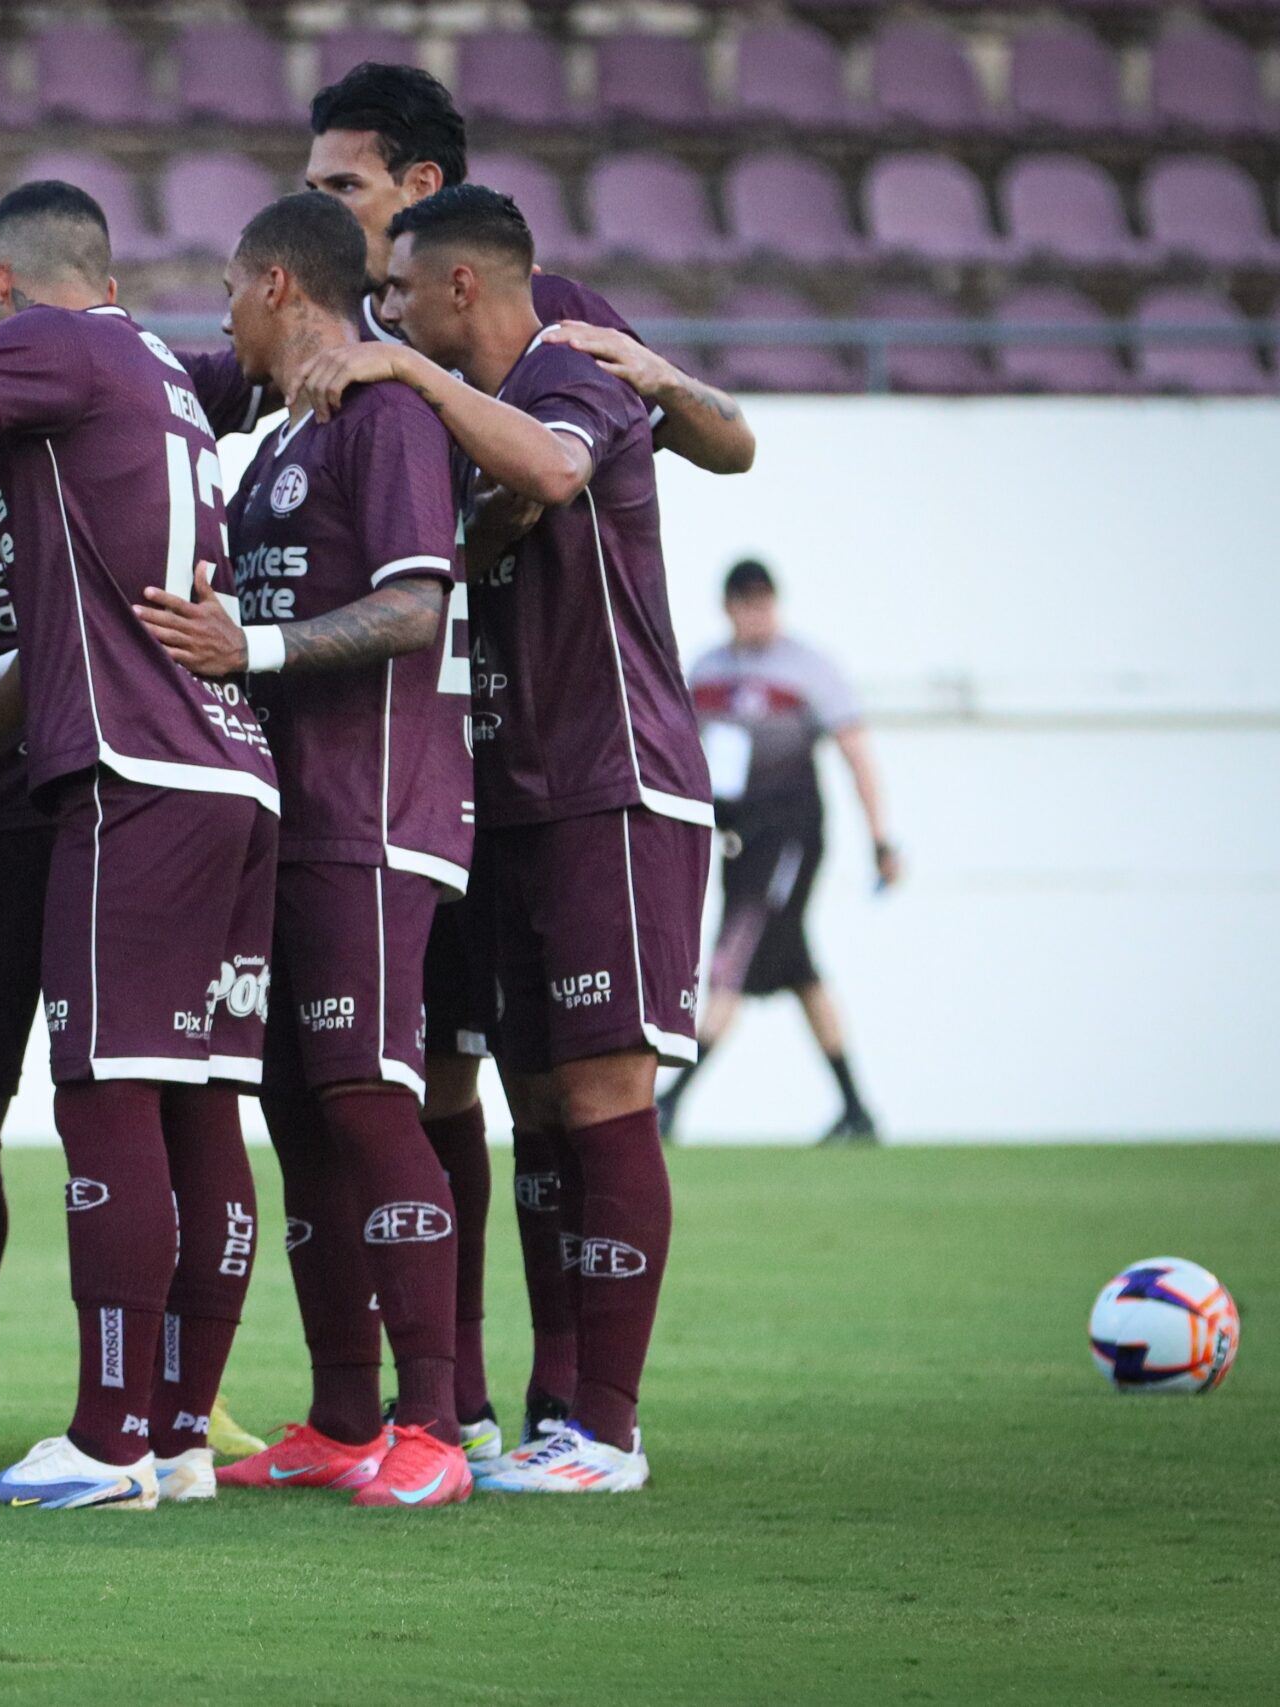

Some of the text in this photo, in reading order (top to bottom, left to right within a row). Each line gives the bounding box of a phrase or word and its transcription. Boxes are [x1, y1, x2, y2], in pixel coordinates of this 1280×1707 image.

[551, 970, 612, 1002] LUPO
[300, 996, 355, 1025] LUPO
[566, 990, 612, 1010] SPORT
[174, 1011, 201, 1032] Dix
[312, 1015, 355, 1033] SPORT
[366, 1203, 444, 1241] AFE
